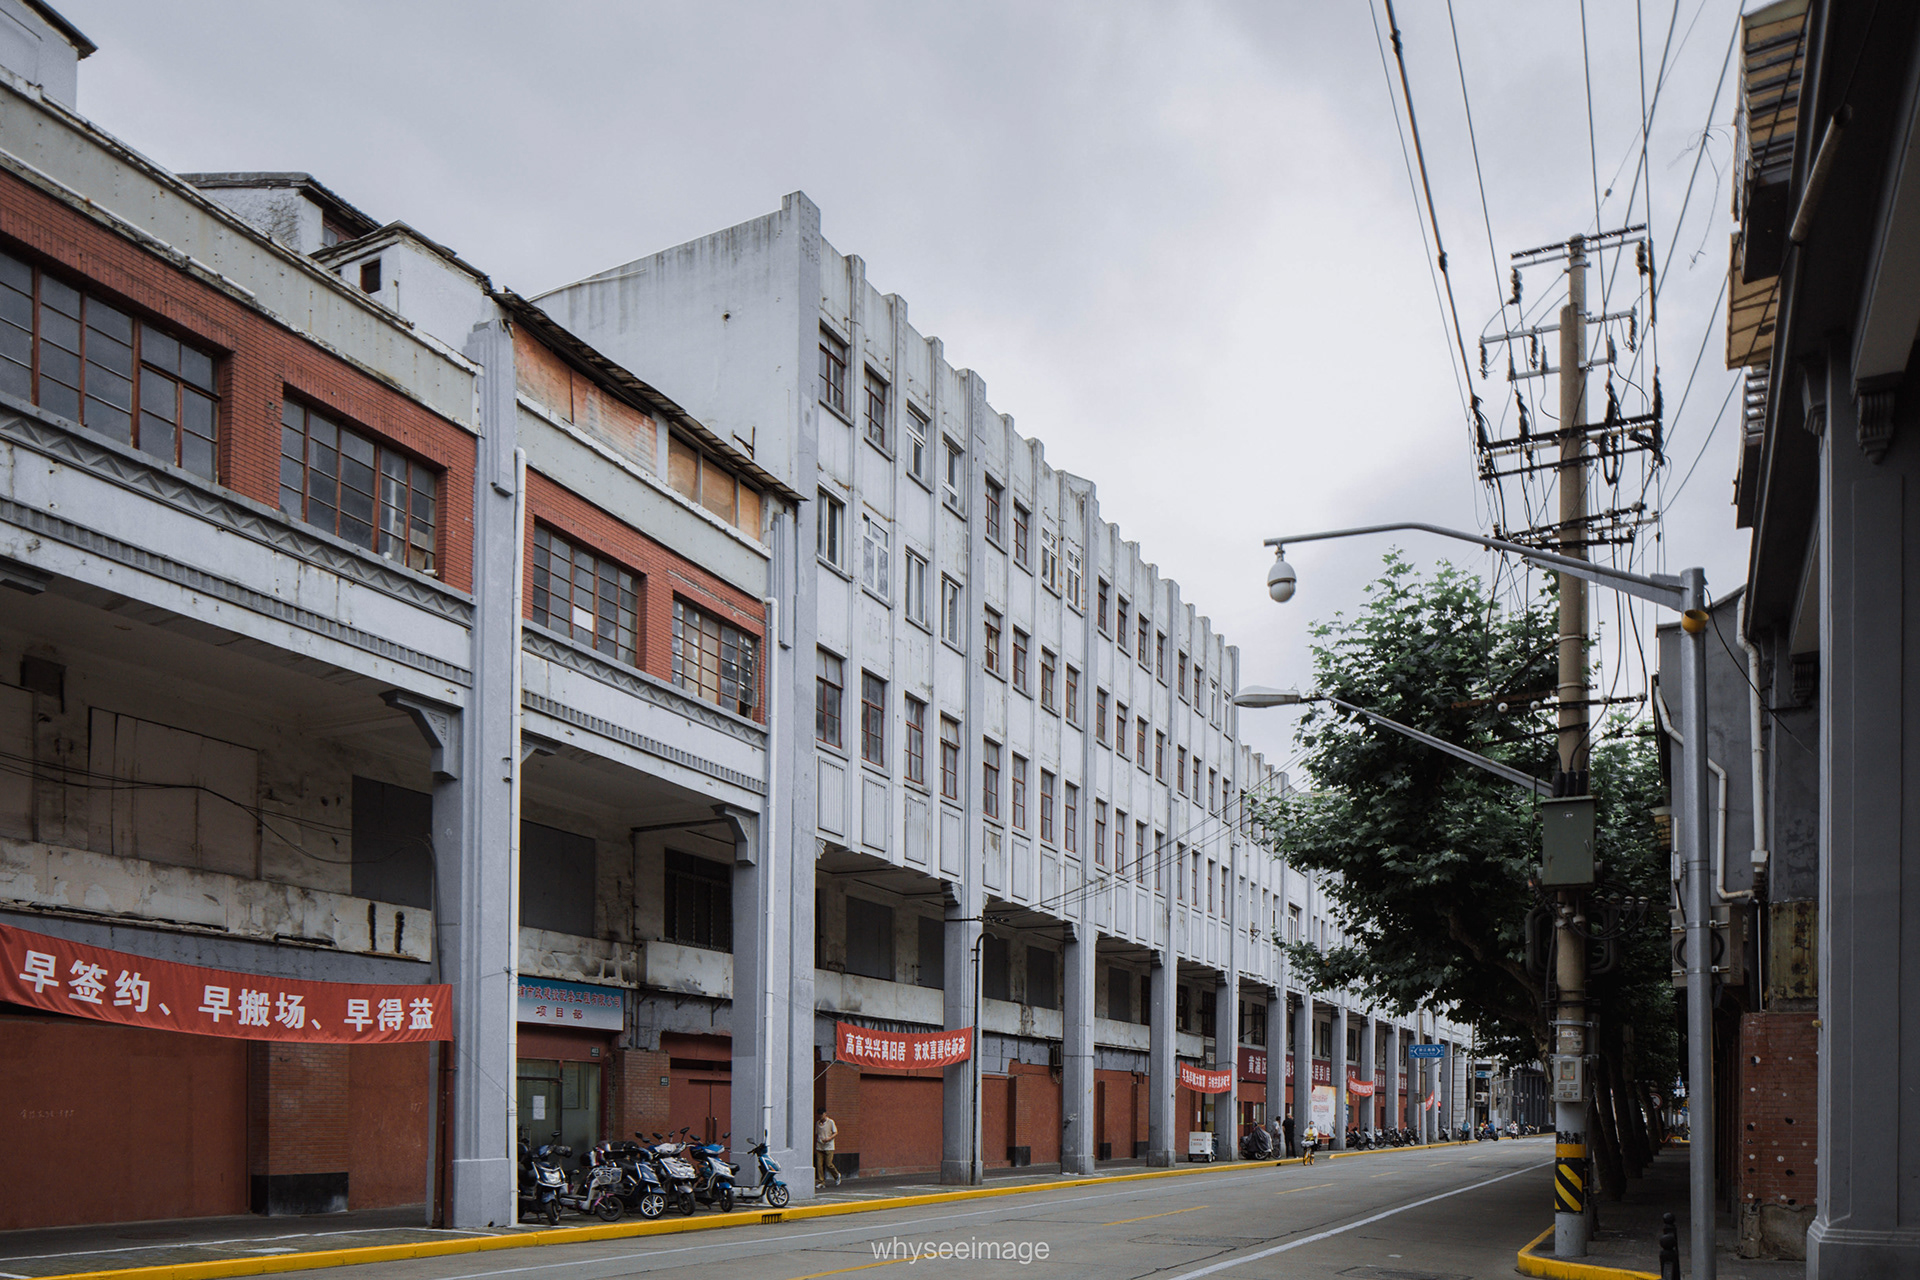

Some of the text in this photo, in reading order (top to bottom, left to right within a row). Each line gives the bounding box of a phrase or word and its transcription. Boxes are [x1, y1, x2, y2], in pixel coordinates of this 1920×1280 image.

[19, 949, 434, 1032] 早签约、早搬场、早得益
[535, 1005, 584, 1020] 项目部
[845, 1033, 907, 1062] 高高兴兴离旧居
